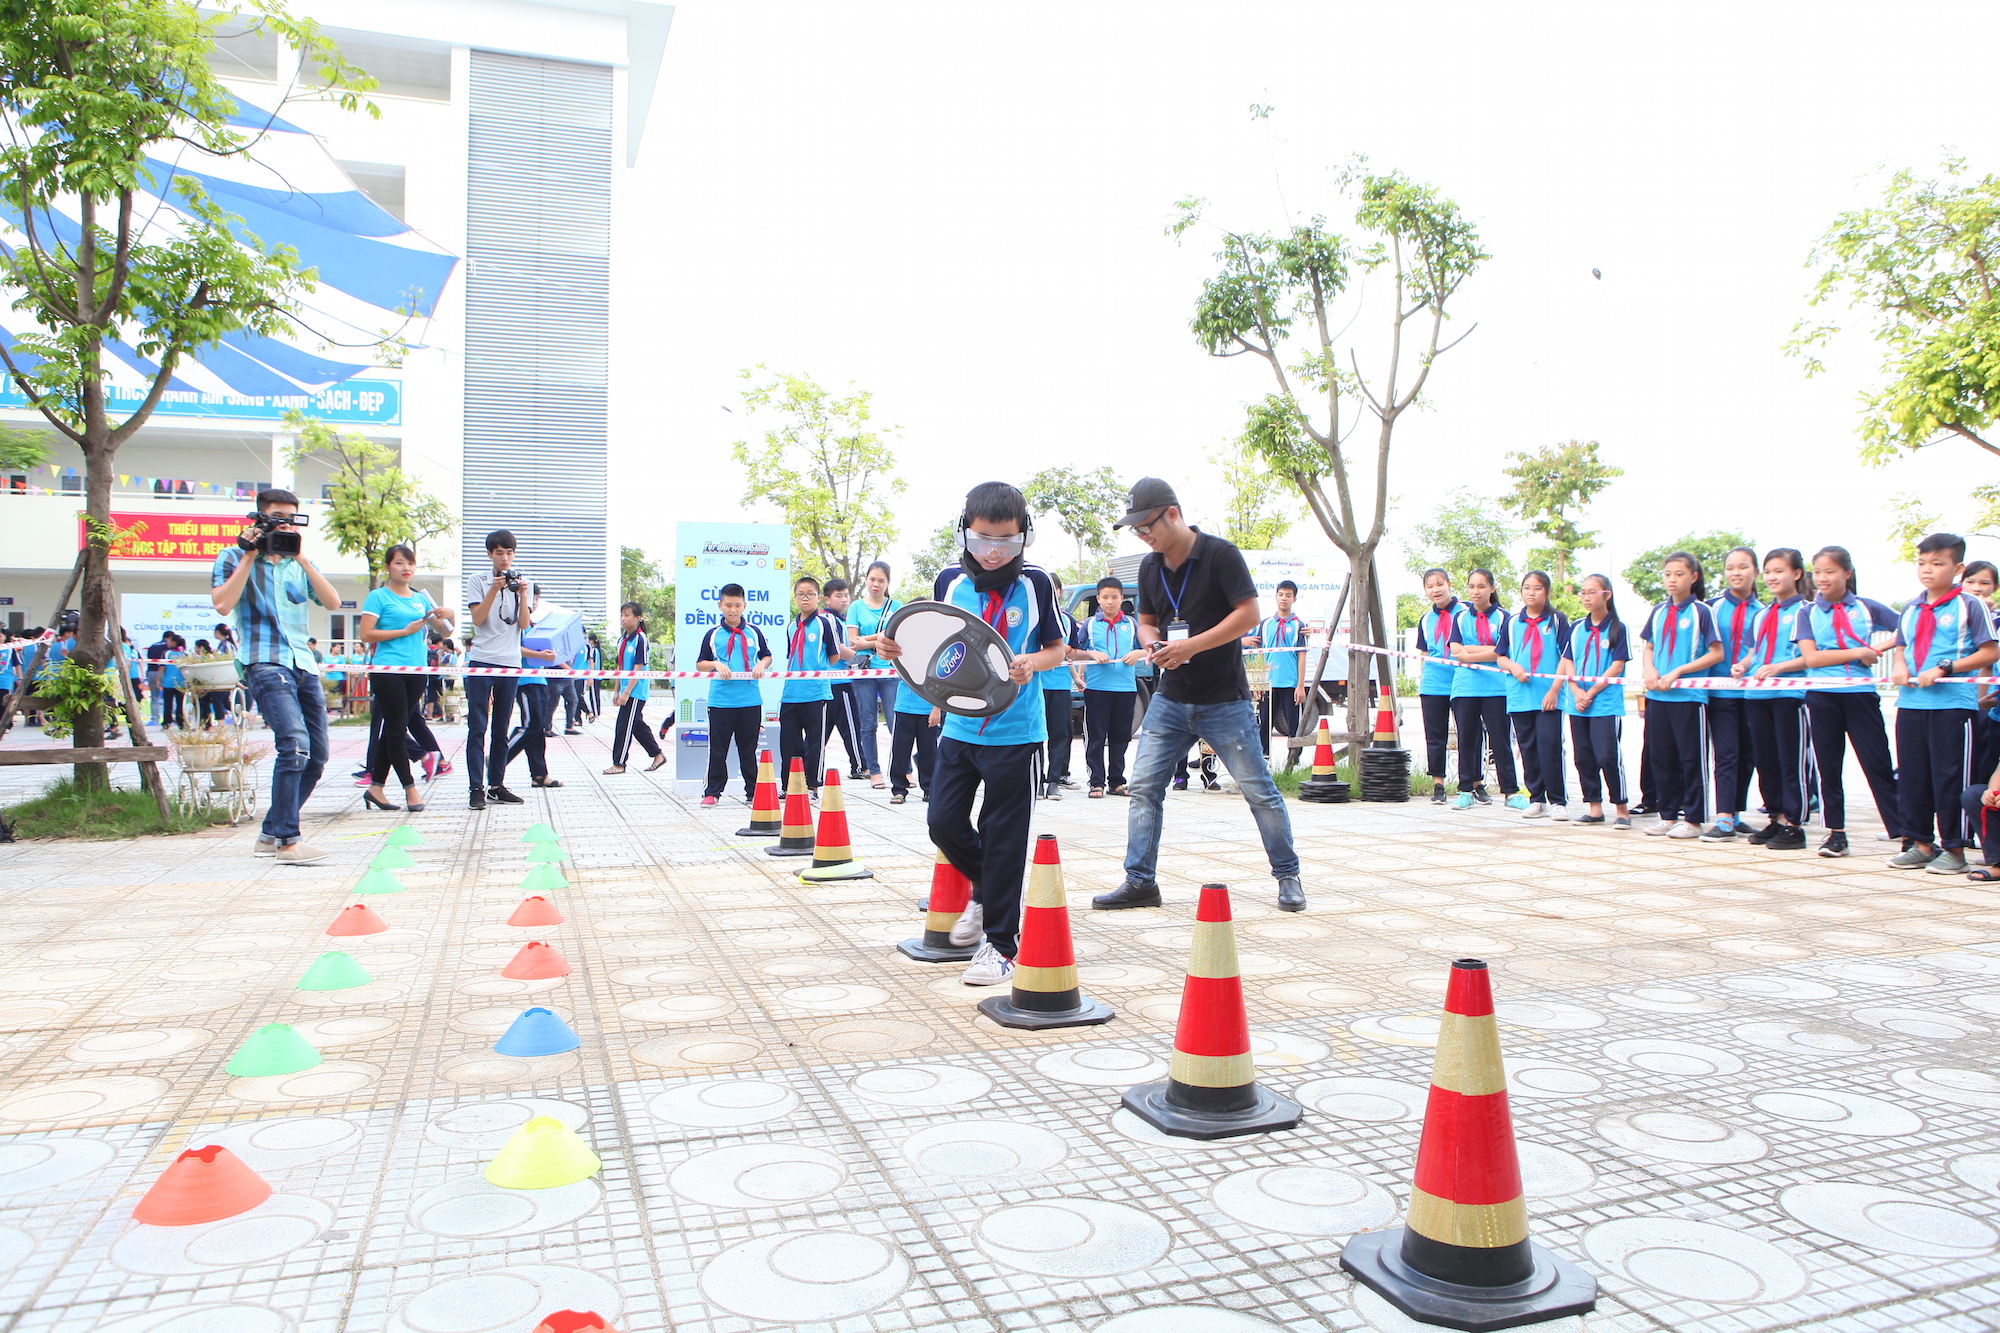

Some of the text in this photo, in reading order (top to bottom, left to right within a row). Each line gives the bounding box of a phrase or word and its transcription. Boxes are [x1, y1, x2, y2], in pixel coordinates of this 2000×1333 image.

[358, 391, 385, 416] ĐẸP
[168, 519, 198, 537] THIẾU
[201, 523, 219, 537] NHI
[156, 539, 177, 557] TẬP
[747, 590, 769, 601] EM
[685, 608, 717, 625] ĐẾN
[938, 646, 963, 675] Ford
